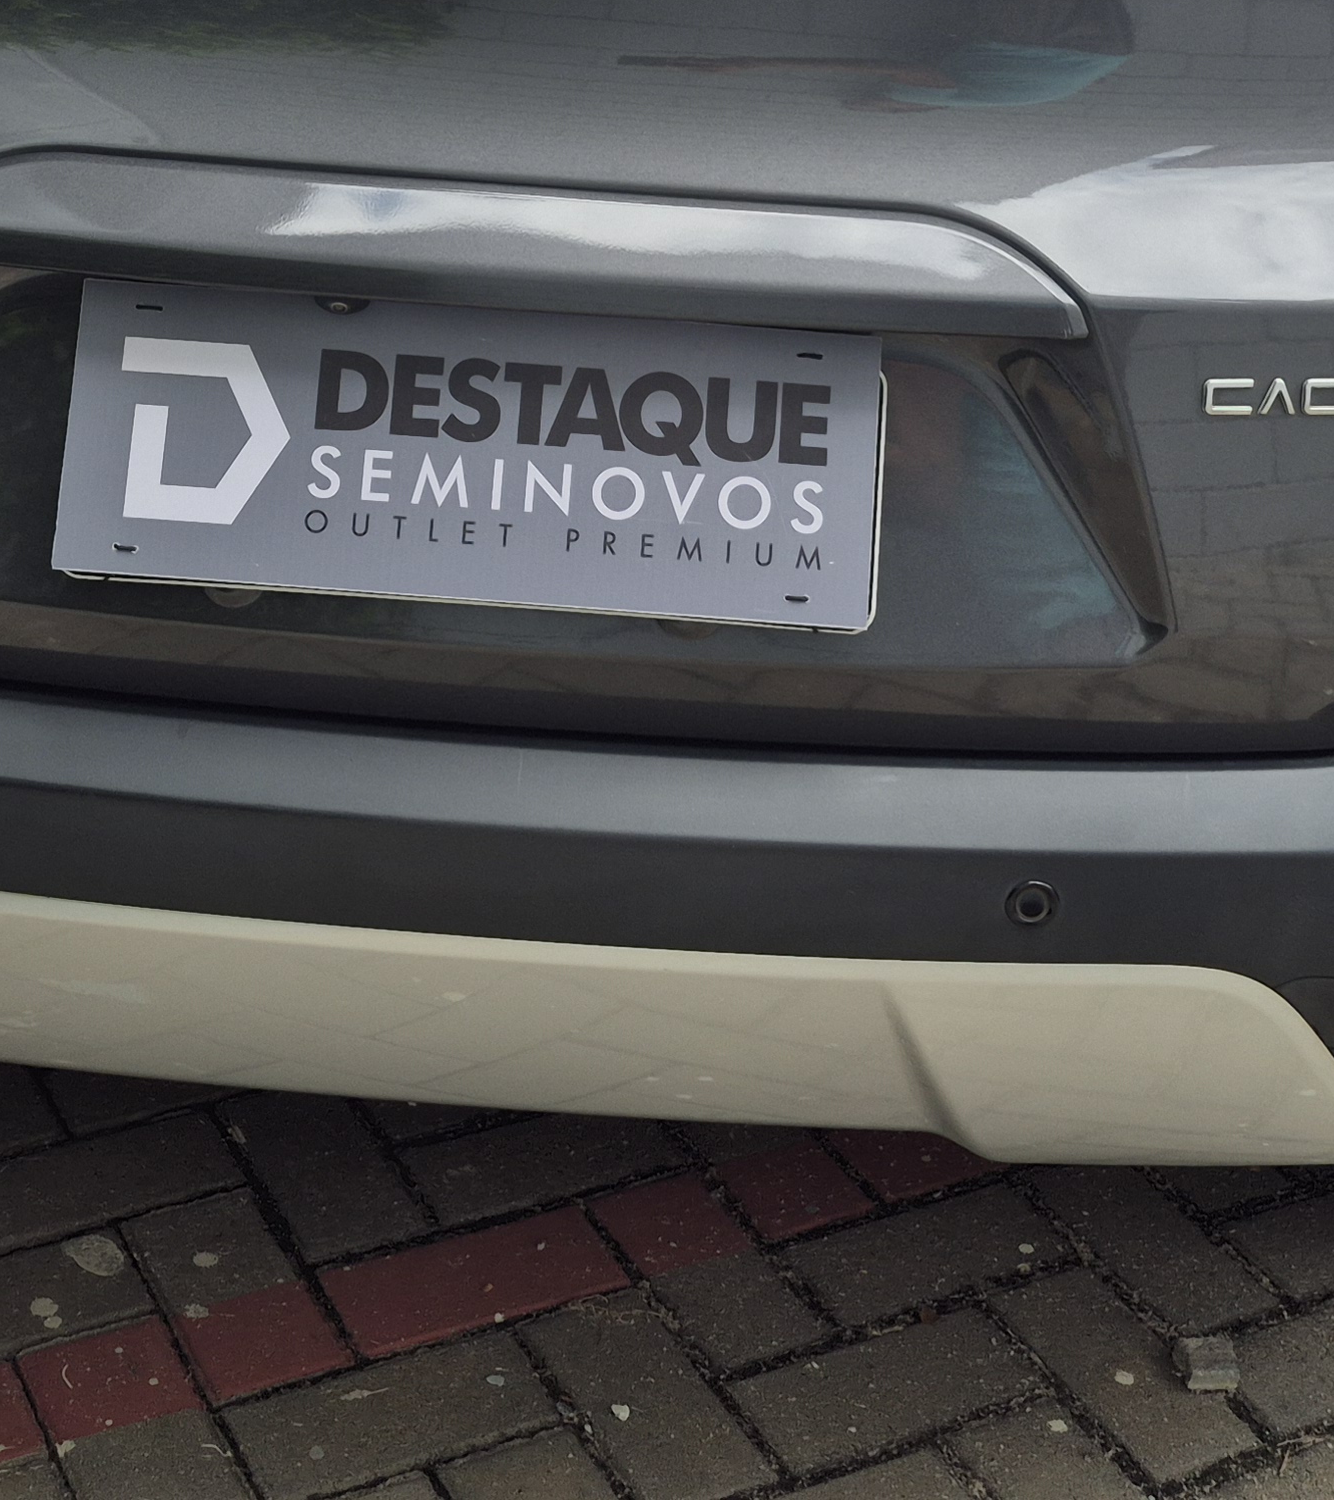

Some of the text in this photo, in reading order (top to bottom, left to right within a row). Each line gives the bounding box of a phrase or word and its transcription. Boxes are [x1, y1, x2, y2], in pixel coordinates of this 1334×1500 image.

[313, 348, 833, 467] DESTAQUE
[307, 444, 825, 536] SEMINOVOS
[304, 509, 823, 572] OUTLET PREMIUM
